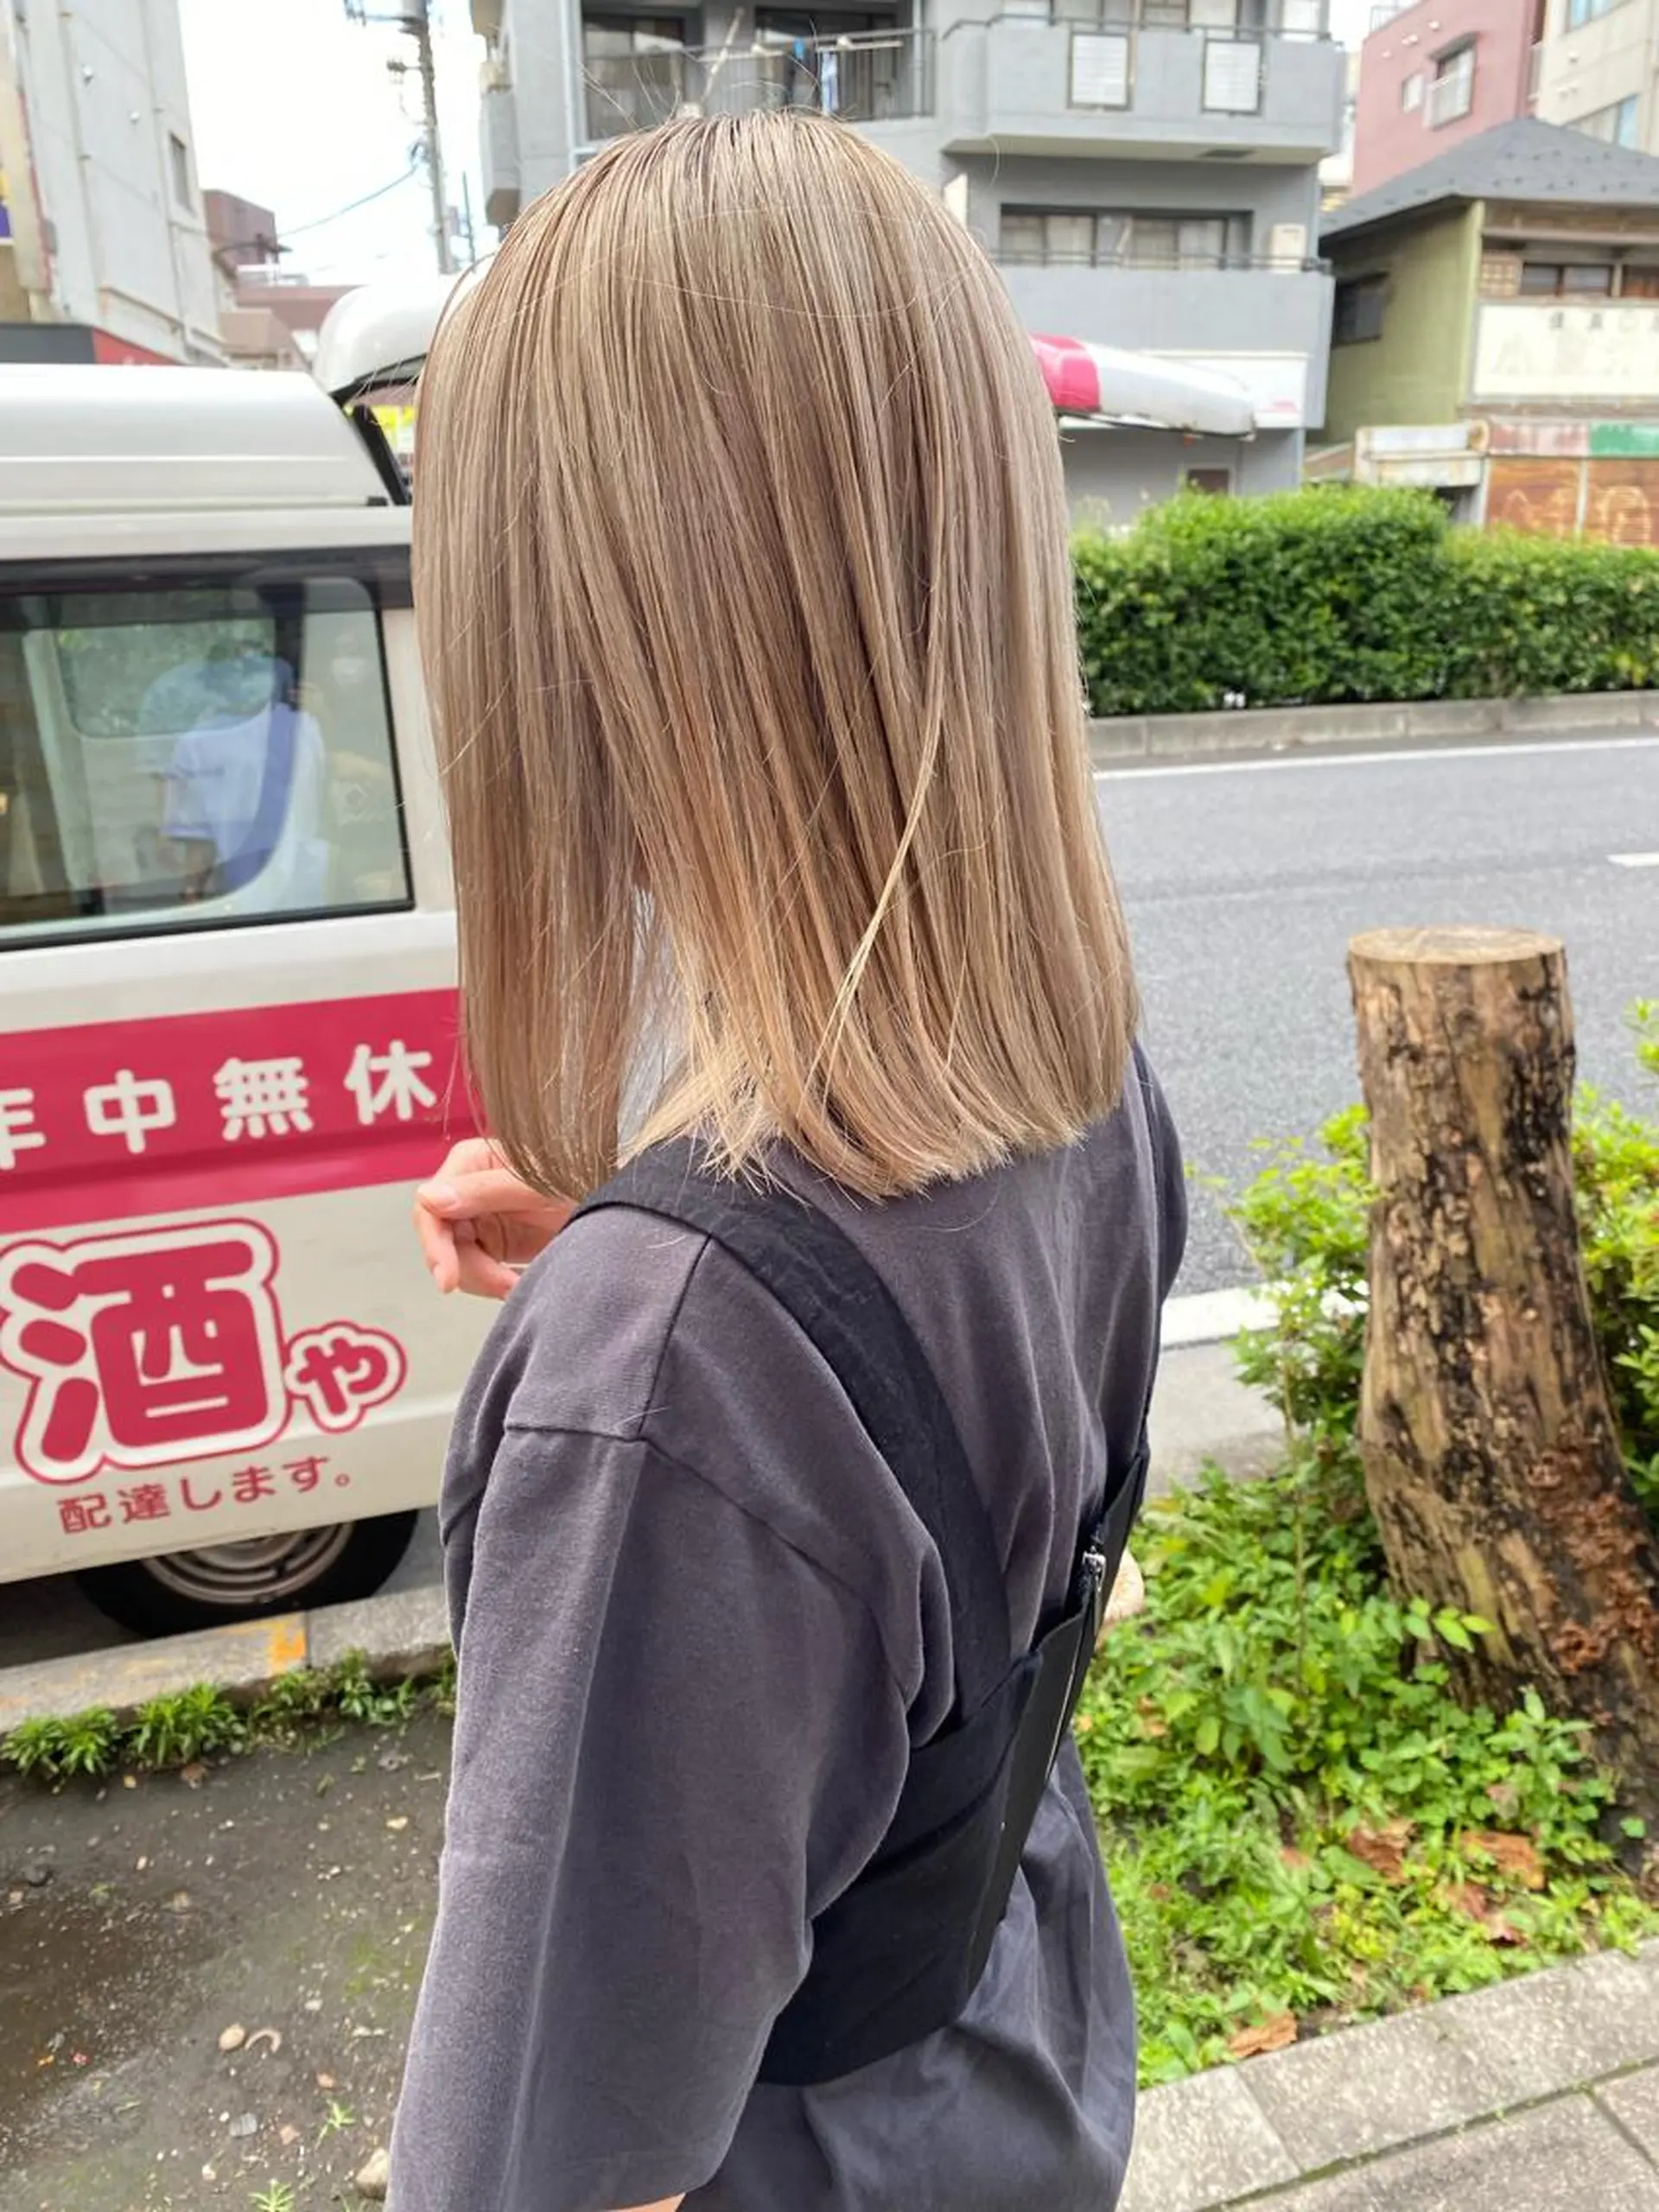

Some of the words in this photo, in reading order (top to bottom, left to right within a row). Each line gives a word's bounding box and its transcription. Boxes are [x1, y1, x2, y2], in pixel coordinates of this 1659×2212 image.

[4, 1229, 399, 1472] 酒や
[58, 1455, 350, 1535] 配達します。
